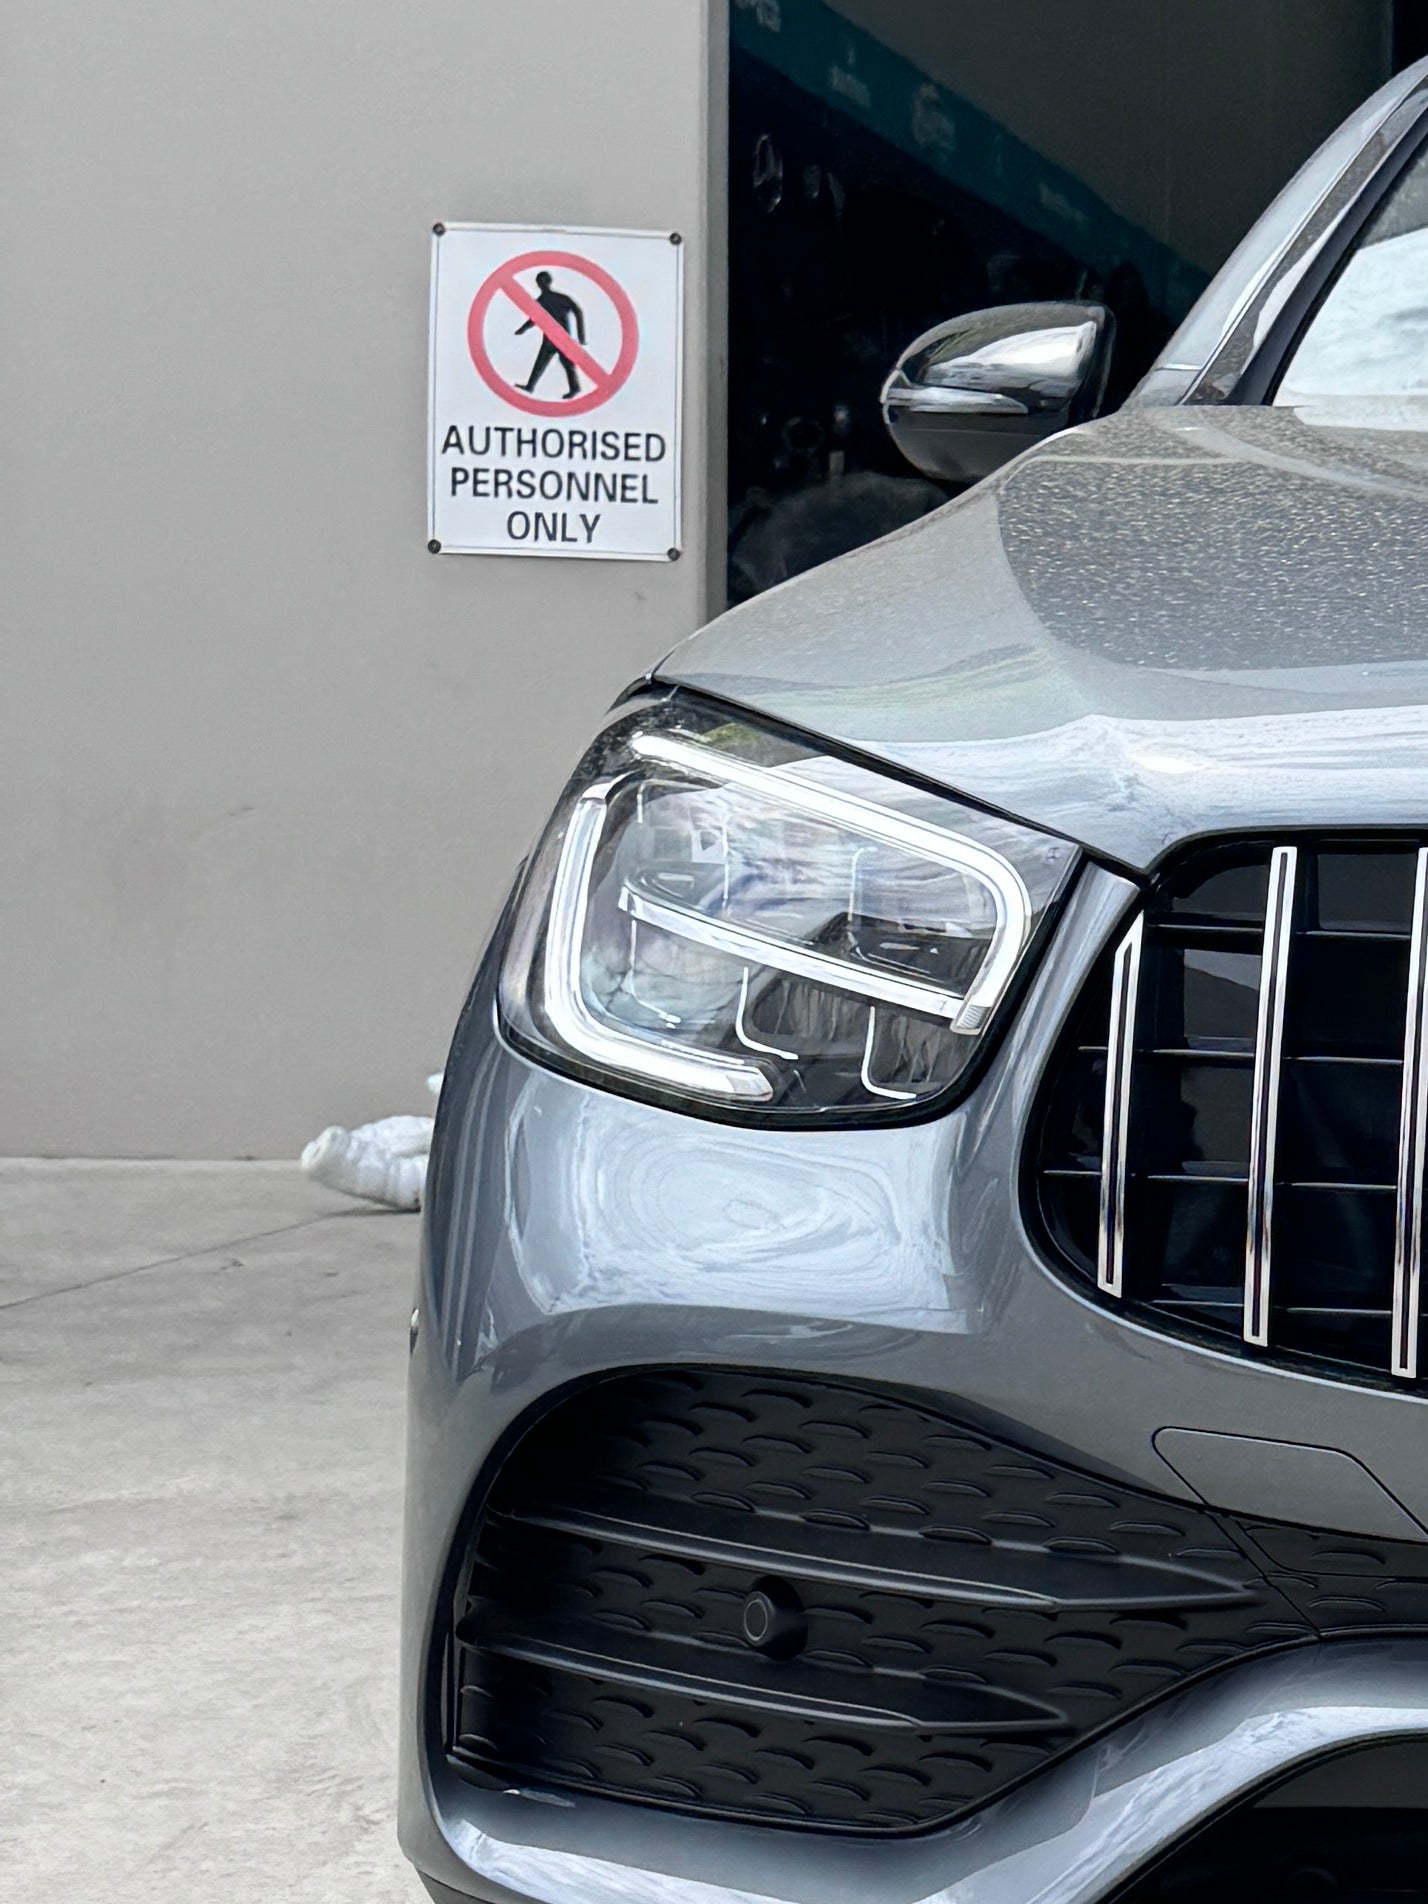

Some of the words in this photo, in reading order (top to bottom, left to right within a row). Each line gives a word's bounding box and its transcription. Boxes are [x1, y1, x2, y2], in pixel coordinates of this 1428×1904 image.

[441, 425, 667, 463] AUTHORISED
[451, 466, 659, 505] PERSONNEL
[506, 510, 602, 544] ONLY
